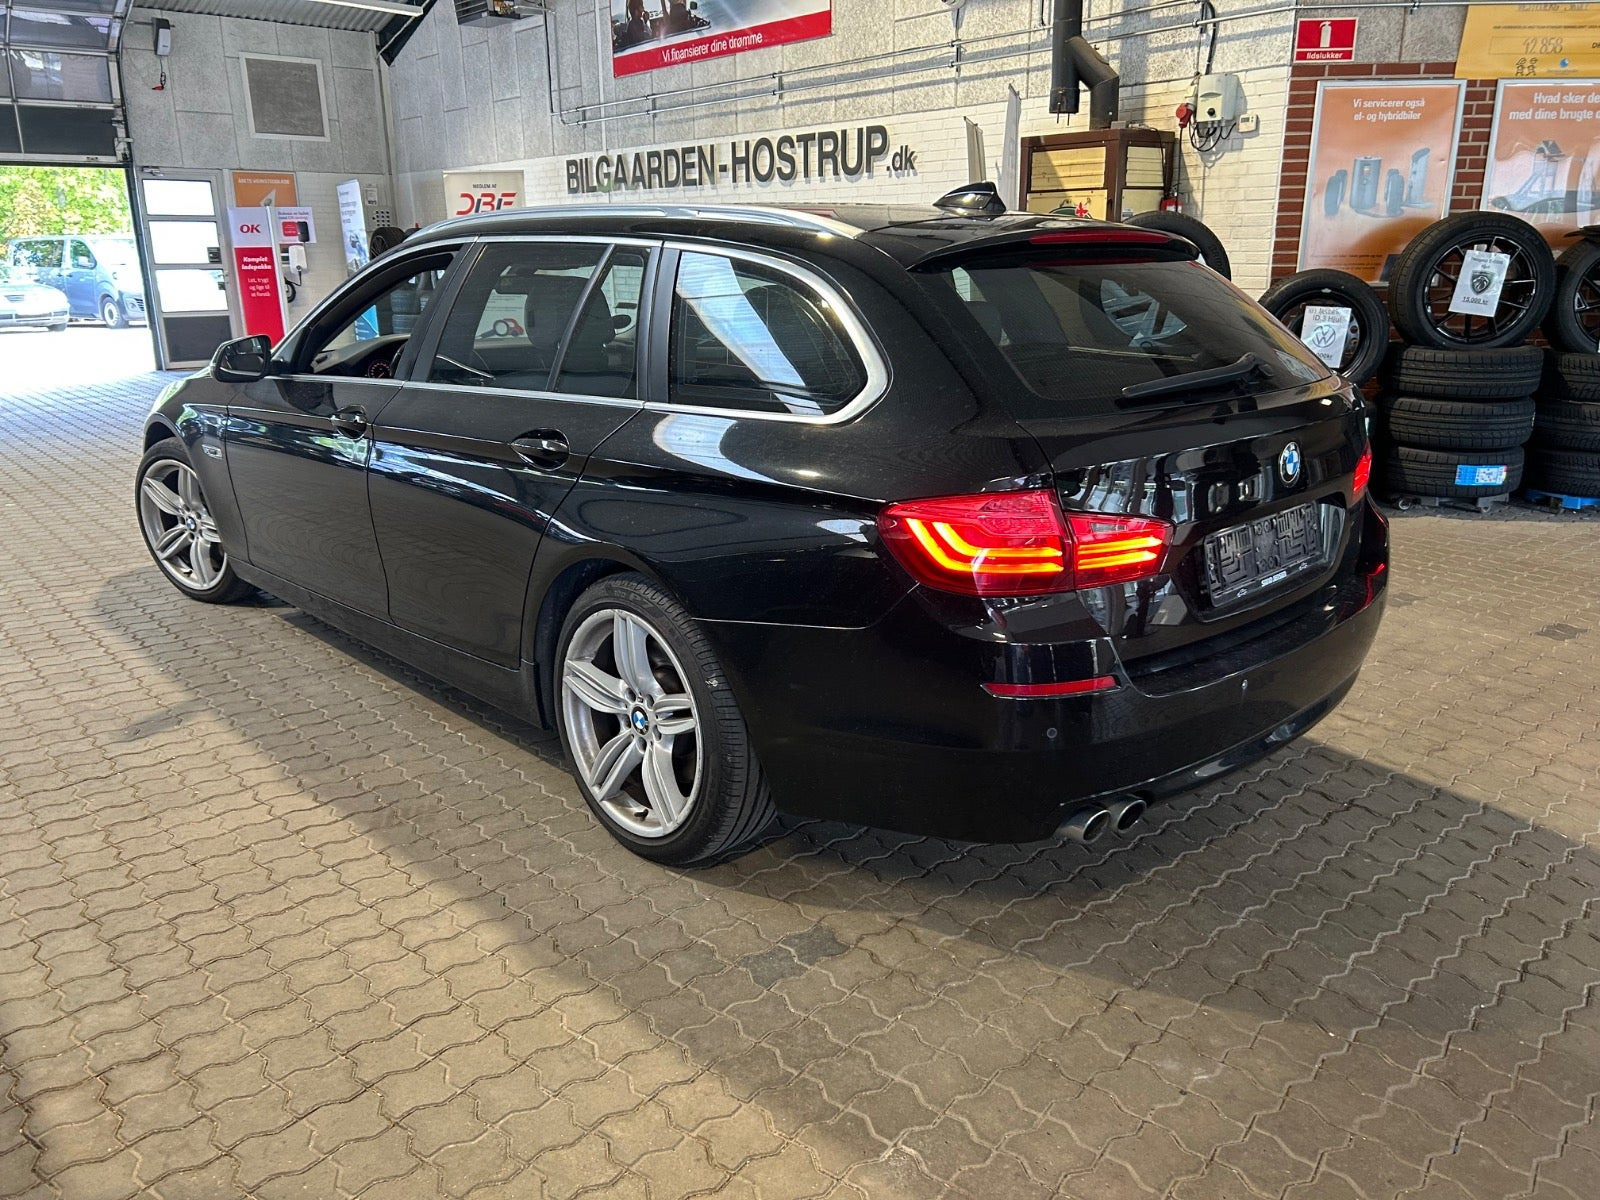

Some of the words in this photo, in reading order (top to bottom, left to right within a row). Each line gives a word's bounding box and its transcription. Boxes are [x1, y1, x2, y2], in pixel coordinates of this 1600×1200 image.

[662, 49, 670, 62] Vi
[671, 43, 709, 61] finansierer
[711, 39, 727, 52] dine
[728, 32, 763, 48] drømme
[1353, 99, 1362, 108] Vi
[1362, 99, 1404, 108] servicerer
[1405, 98, 1425, 109] også
[1533, 92, 1561, 104] Hvad
[1562, 92, 1586, 104] sker
[1366, 113, 1377, 122] og
[1379, 110, 1421, 122] hybridbiler
[1509, 108, 1533, 120] med
[1535, 108, 1557, 120] dine
[1560, 108, 1593, 122] brugte
[240, 224, 261, 234] OK
